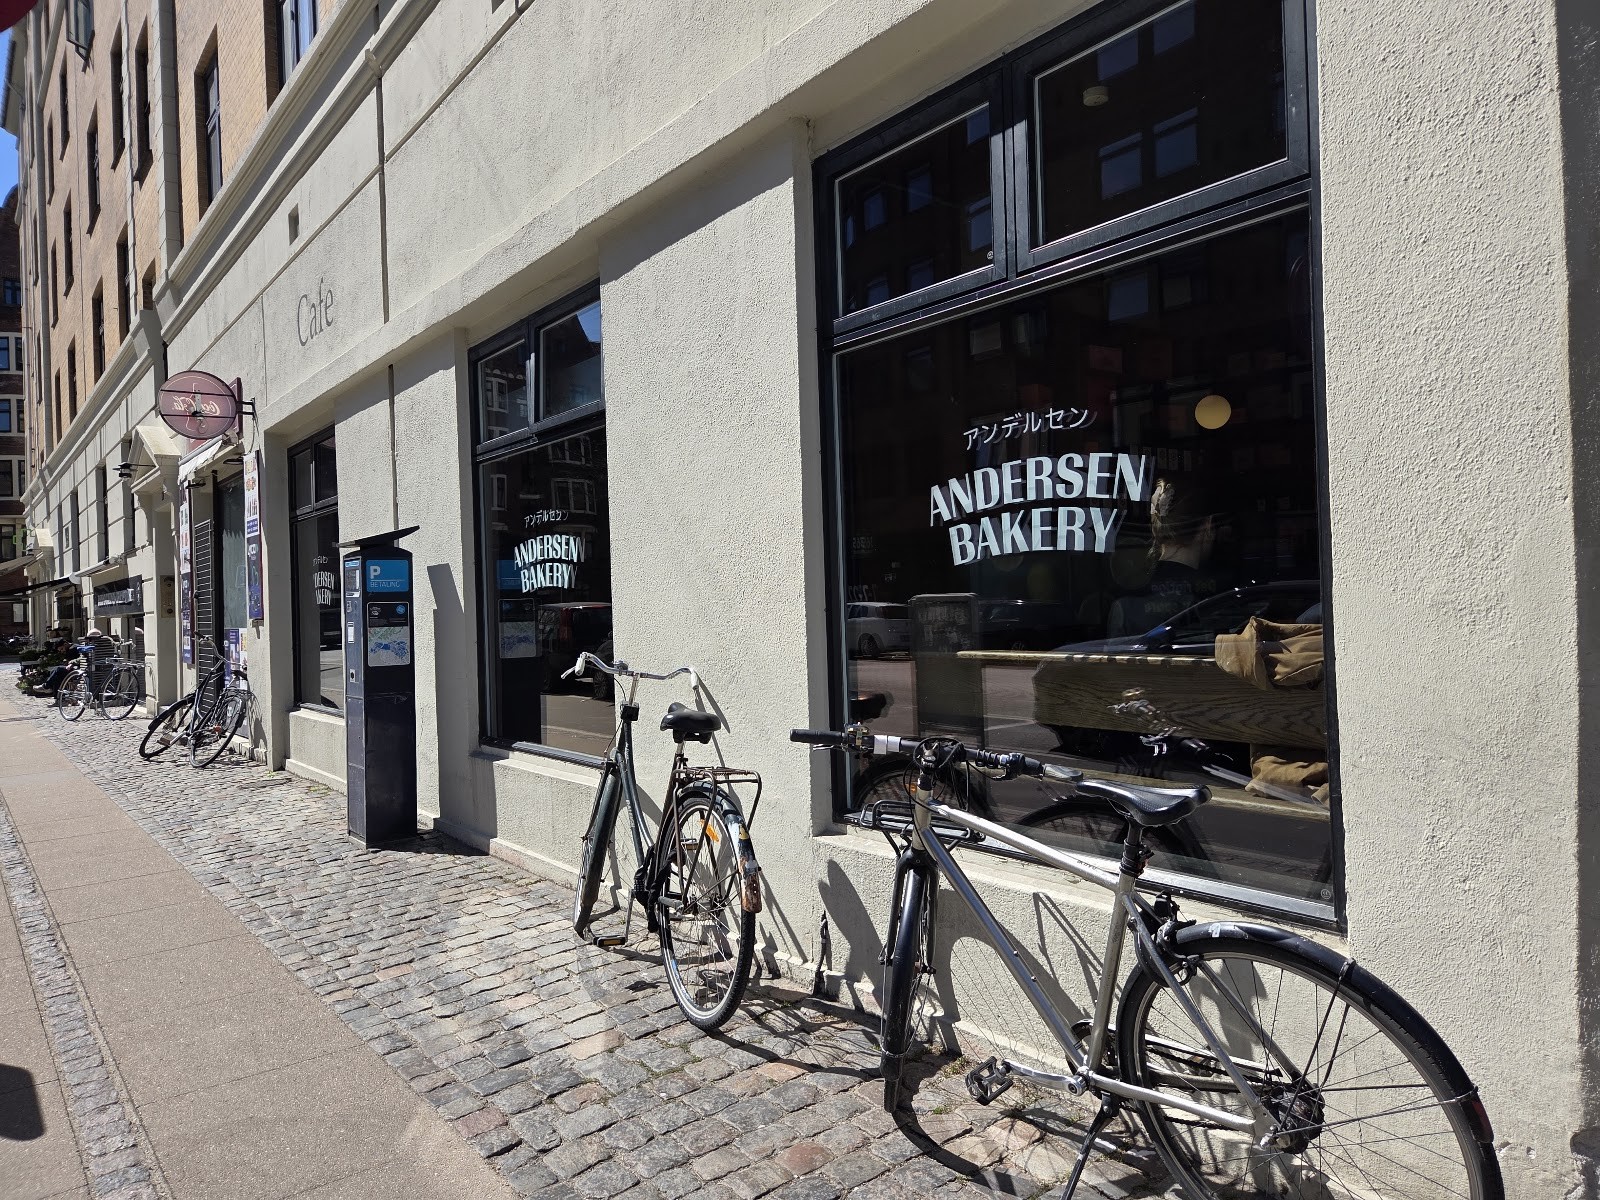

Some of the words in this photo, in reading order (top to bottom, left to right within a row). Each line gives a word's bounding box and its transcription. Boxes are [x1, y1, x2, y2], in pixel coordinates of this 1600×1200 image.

[297, 276, 334, 346] Cafe
[963, 407, 1089, 450] アンデルセン
[929, 452, 1147, 527] ANDERSEN
[523, 508, 564, 529] アンデルセン
[948, 506, 1119, 566] BAKERY
[513, 534, 580, 571] ANDERSEN
[312, 571, 335, 590] DERSEN
[370, 565, 381, 580] P
[520, 562, 572, 593] BAKERY
